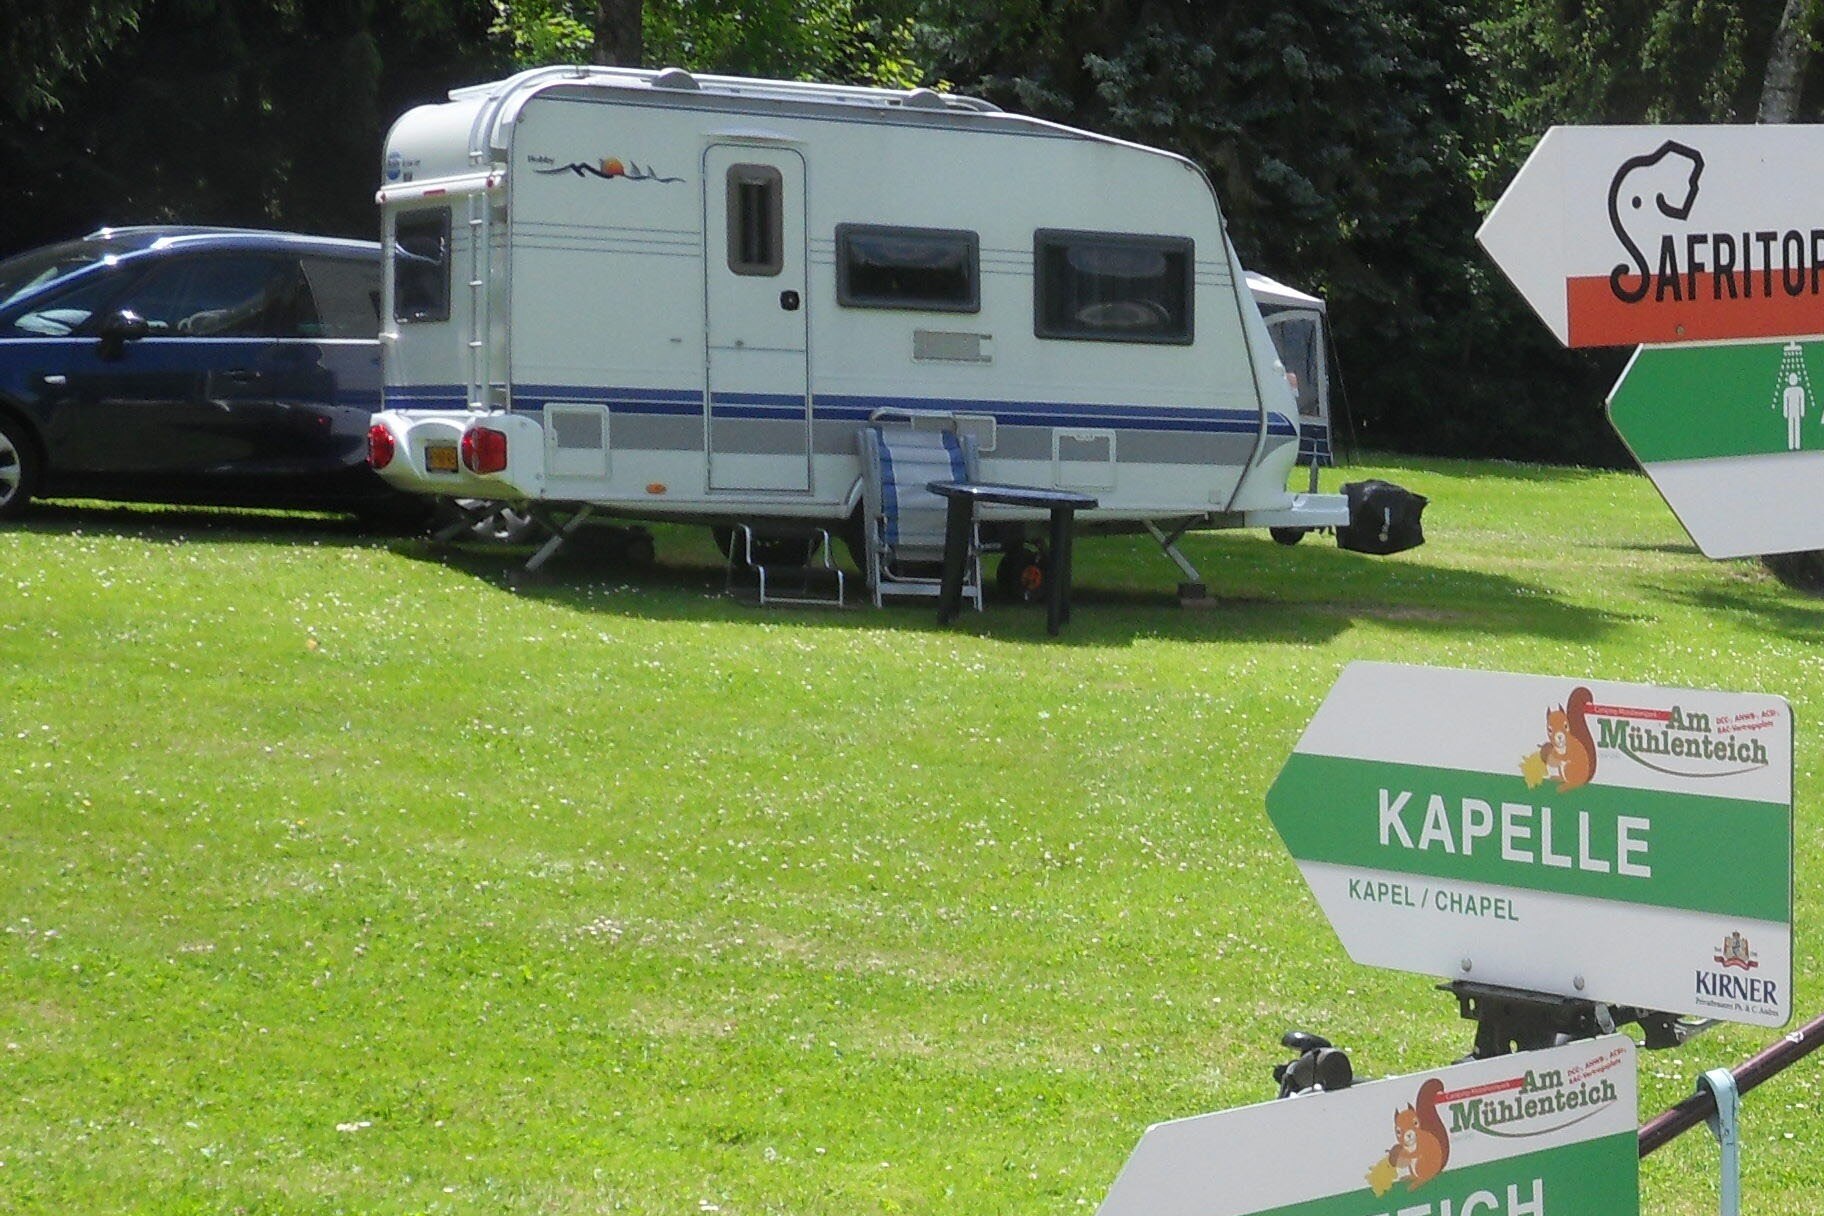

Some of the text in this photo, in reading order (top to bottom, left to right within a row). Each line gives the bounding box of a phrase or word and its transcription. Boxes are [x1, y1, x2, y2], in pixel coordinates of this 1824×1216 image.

[1666, 706, 1711, 733] Am
[1596, 719, 1769, 765] Mühlenteich
[1378, 788, 1652, 878] KAPELLE
[1349, 878, 1415, 907] KAPEL
[1435, 890, 1519, 921] CHAPEL
[1696, 970, 1778, 1005] KIRNER
[1518, 1069, 1563, 1095] Am
[1449, 1079, 1617, 1133] Mühlenteich
